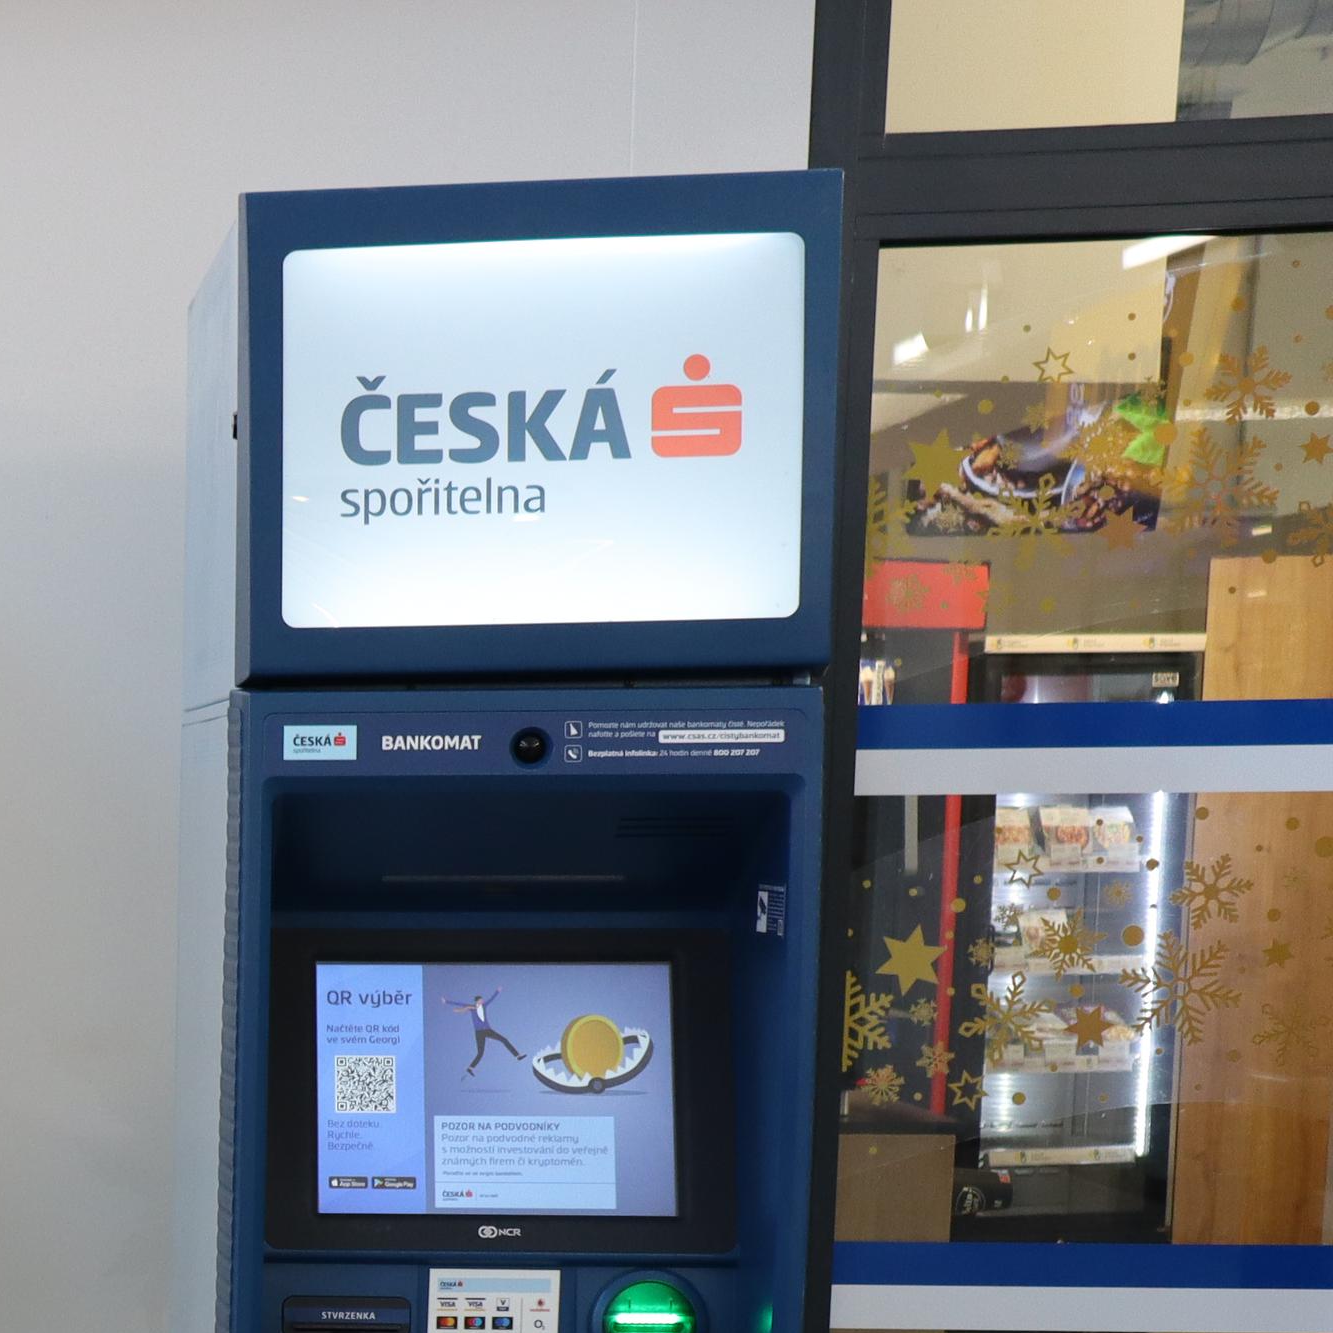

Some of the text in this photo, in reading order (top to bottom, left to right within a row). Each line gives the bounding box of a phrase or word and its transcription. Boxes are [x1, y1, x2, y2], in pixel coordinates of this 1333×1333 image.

[340, 368, 632, 466] ČESKÁ
[339, 476, 546, 525] spořitelna
[292, 733, 332, 747] ČESKÁ
[381, 734, 482, 751] BANKOMAT
[588, 750, 624, 758] Bezplatná
[669, 749, 689, 757] hodin
[713, 749, 729, 757] 800
[730, 749, 744, 757] 207
[745, 748, 760, 757] 207
[326, 989, 413, 1008] QR výběr
[326, 1023, 400, 1034] Načtěte QR kód
[327, 1119, 345, 1128] Bez
[441, 1121, 560, 1131] POZOR NA PODVODNÍKY
[441, 1133, 469, 1142] Pozor
[486, 1133, 536, 1145] podvodné
[537, 1133, 579, 1145] reklamy
[441, 1146, 447, 1154] s
[556, 1145, 569, 1155] do
[571, 1145, 609, 1157] veřejně
[441, 1157, 487, 1168] známých
[488, 1157, 515, 1167] firem
[498, 1228, 521, 1237] NCR
[320, 1310, 376, 1321] STVRZENKA
